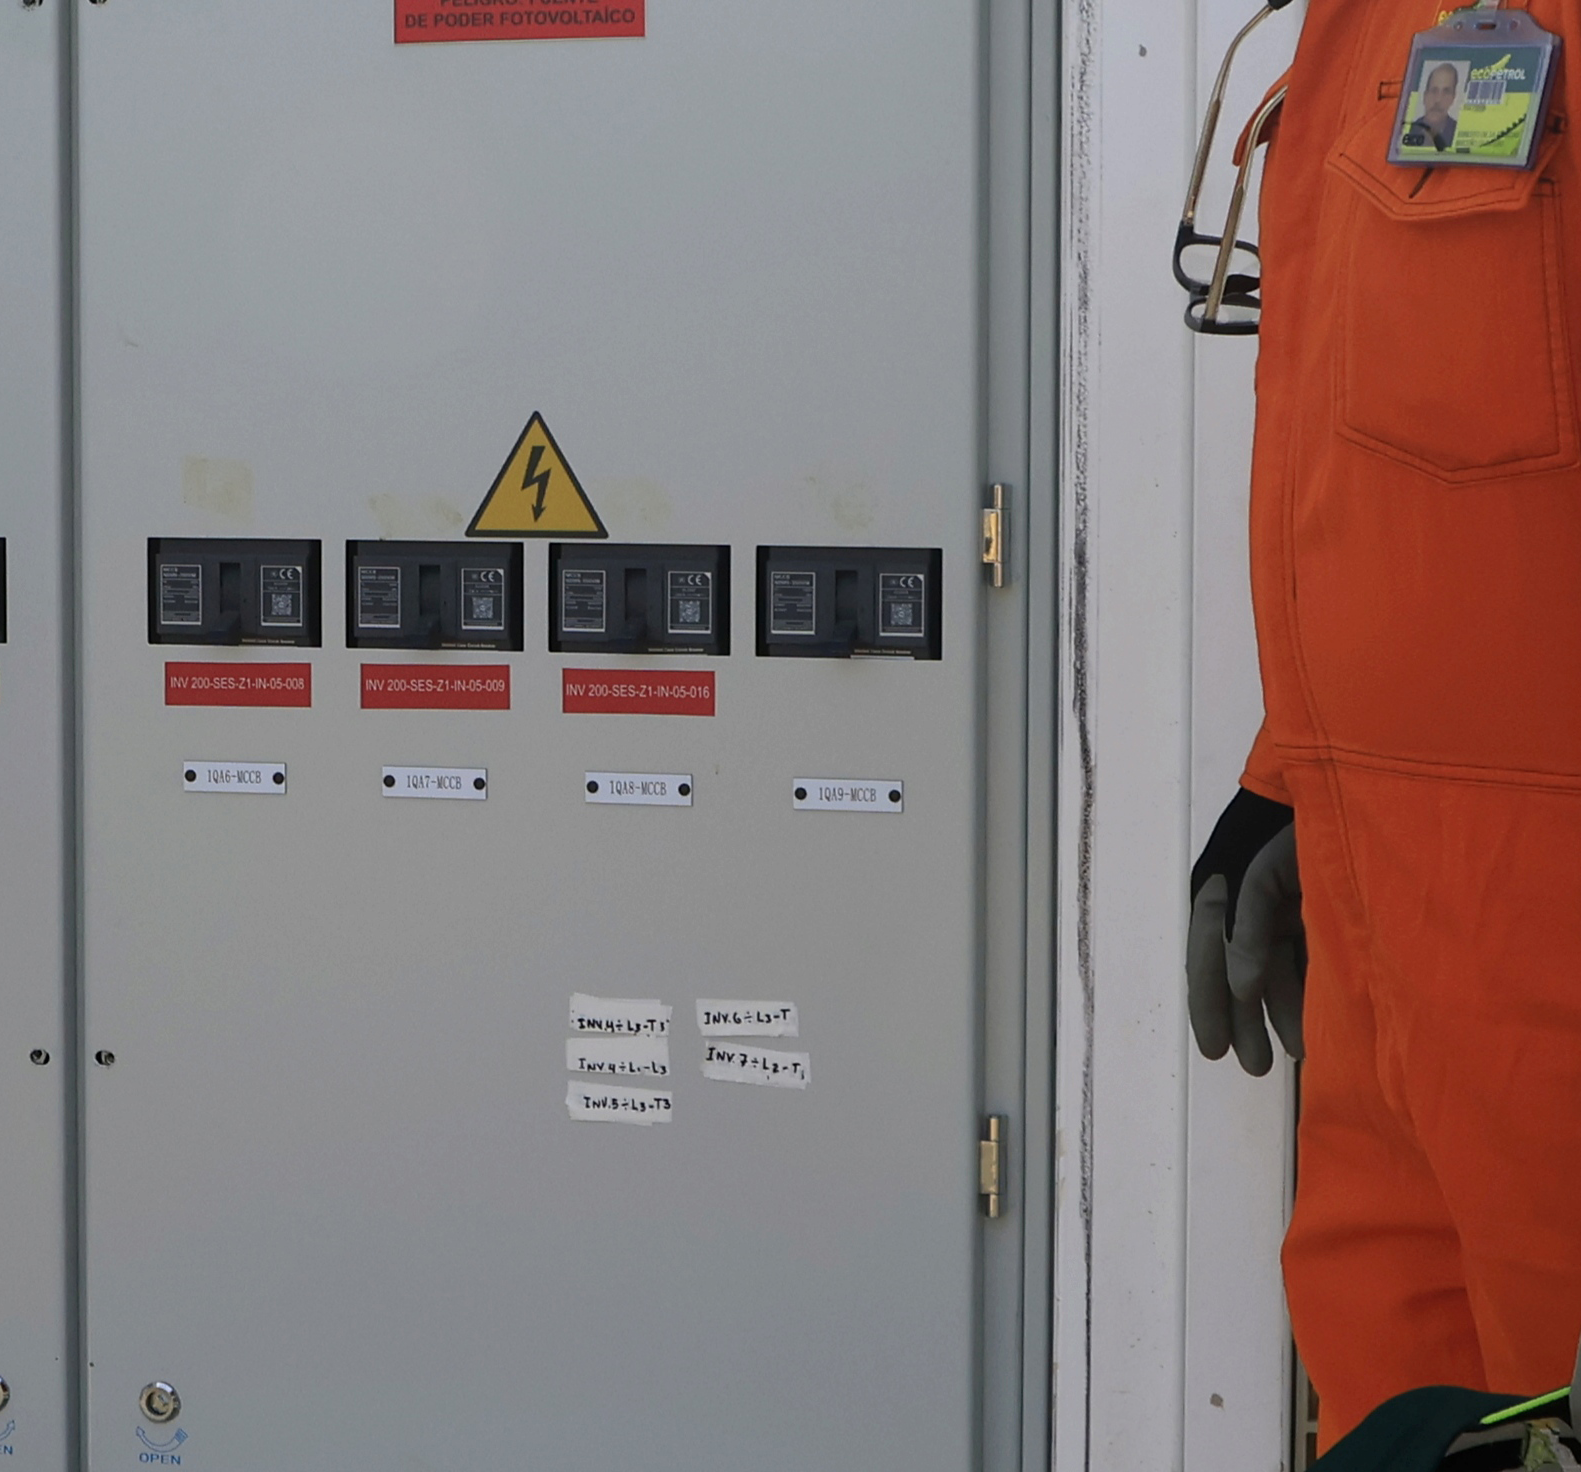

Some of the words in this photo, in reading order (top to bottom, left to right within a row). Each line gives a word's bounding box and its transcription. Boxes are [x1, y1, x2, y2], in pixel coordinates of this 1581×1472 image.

[405, 13, 428, 29] DE
[436, 11, 494, 28] PODER
[499, 5, 636, 27] FOTOVOLTAÍCO
[170, 677, 189, 688] INV
[365, 678, 385, 691] INV
[566, 684, 586, 697] INV
[139, 1453, 181, 1466] OPEN
